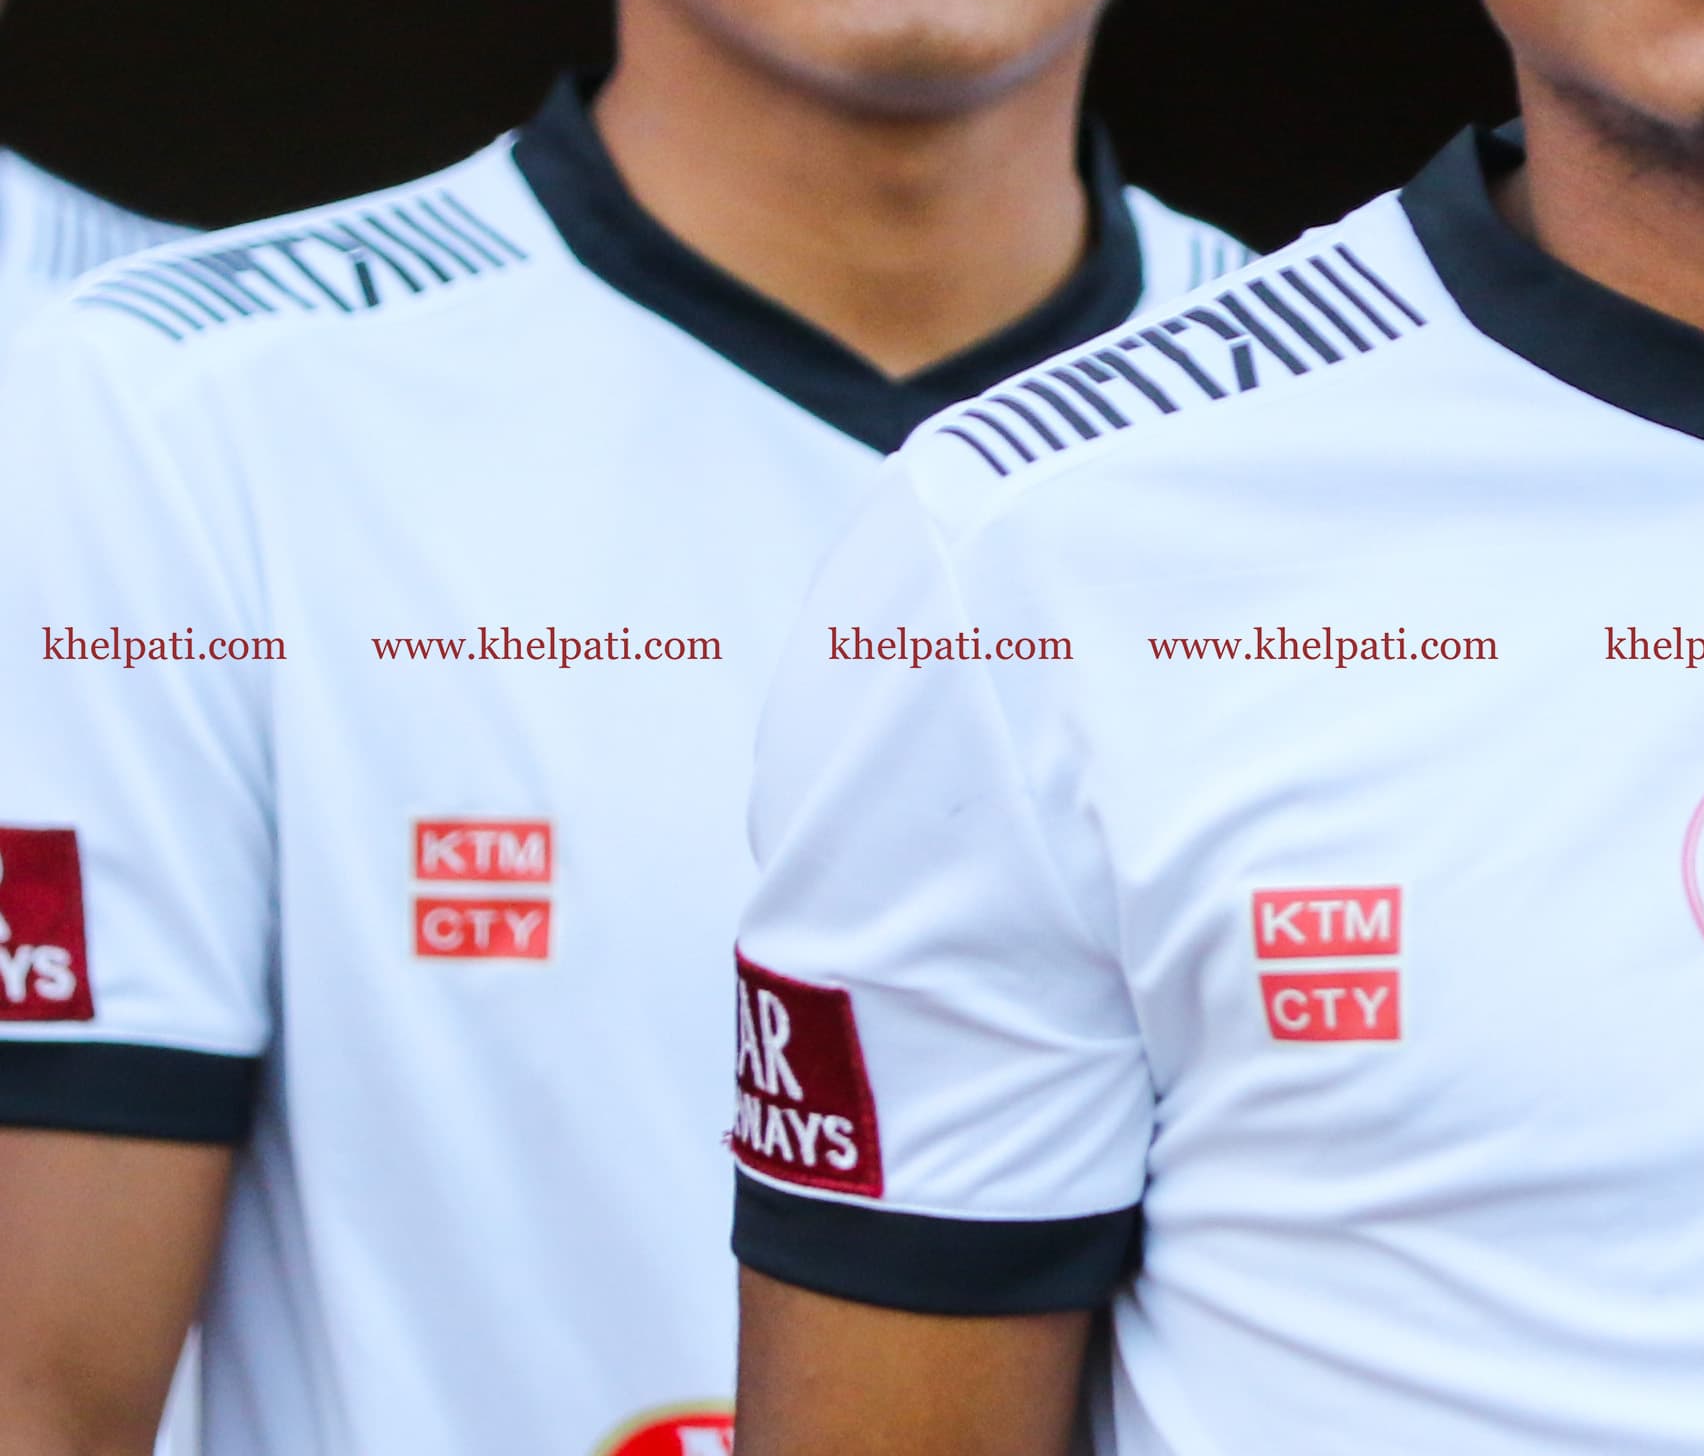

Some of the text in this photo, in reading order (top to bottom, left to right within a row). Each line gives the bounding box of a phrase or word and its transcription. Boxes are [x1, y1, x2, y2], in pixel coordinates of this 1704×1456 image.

[422, 830, 546, 874] KTM
[422, 907, 544, 952] CTY
[1261, 898, 1391, 945] KTM
[1272, 986, 1389, 1031] CTY
